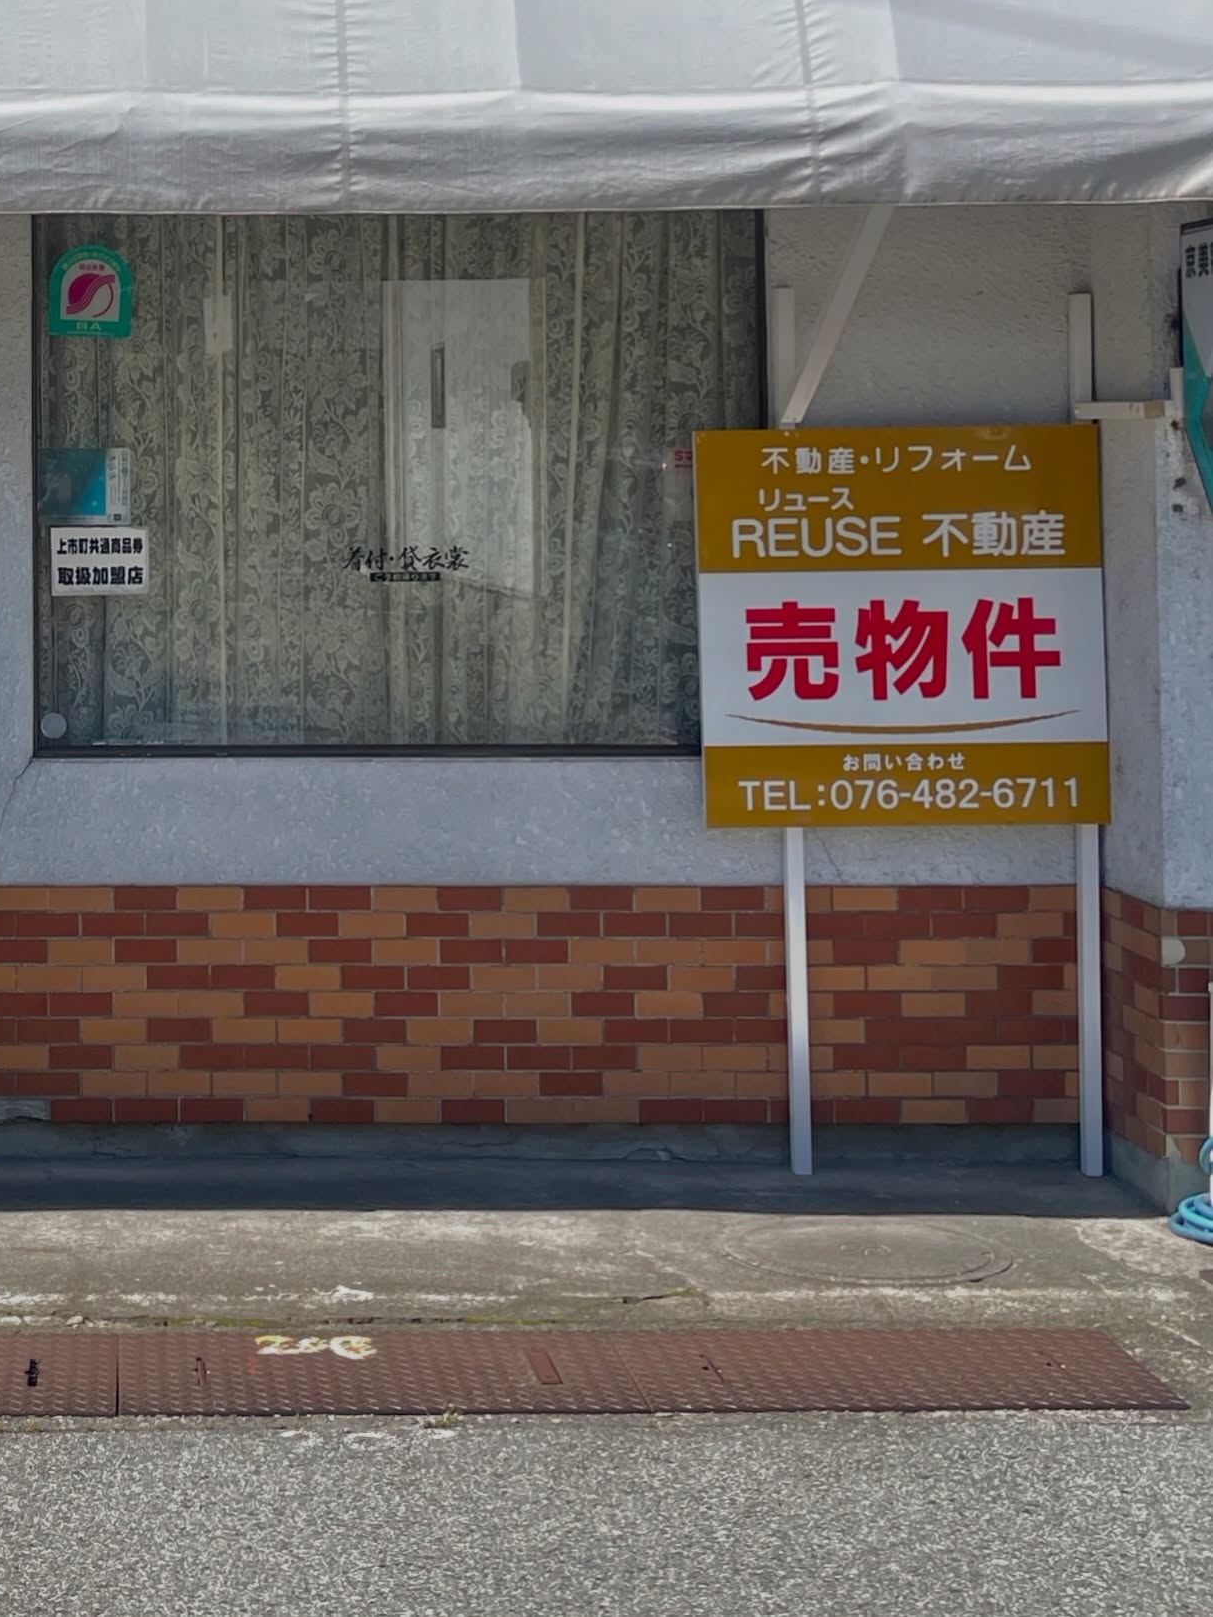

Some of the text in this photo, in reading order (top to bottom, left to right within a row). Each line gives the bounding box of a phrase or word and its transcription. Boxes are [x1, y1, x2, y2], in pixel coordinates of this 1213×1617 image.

[761, 444, 1032, 475] 不動産・リフォーム
[757, 486, 855, 511] リュース
[56, 536, 144, 555] 上市町共通商品券
[731, 509, 1067, 559] REUSE 不動産
[57, 566, 144, 586] 取扱加盟店
[745, 597, 1062, 702] 売物件
[842, 752, 966, 773] お問い合わせ
[738, 776, 1080, 812] TEL:076-482-6711
